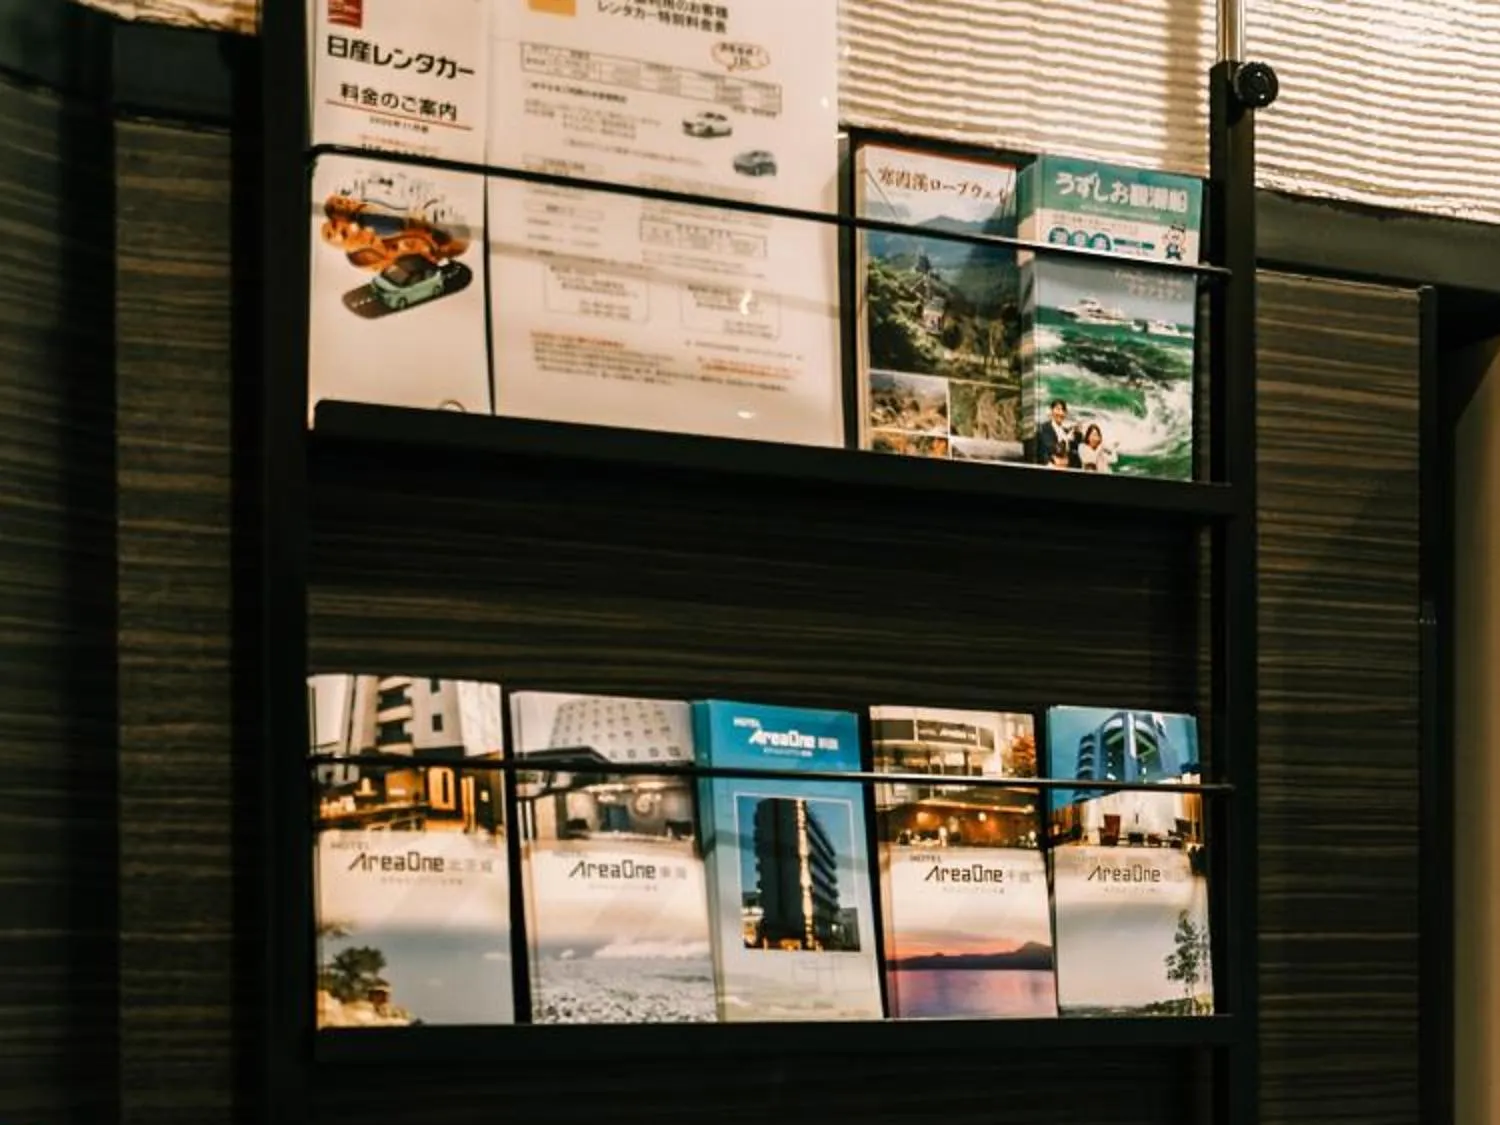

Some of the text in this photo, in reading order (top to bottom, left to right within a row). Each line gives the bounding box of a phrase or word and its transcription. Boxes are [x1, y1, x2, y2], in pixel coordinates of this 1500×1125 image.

[327, 35, 475, 79] 日産レンタカー
[340, 83, 457, 121] 料金のご案内
[348, 851, 445, 872] AreaOne
[568, 859, 657, 879] AreaOne
[924, 864, 1004, 883] AreaOne
[1088, 863, 1161, 882] AreaOne
